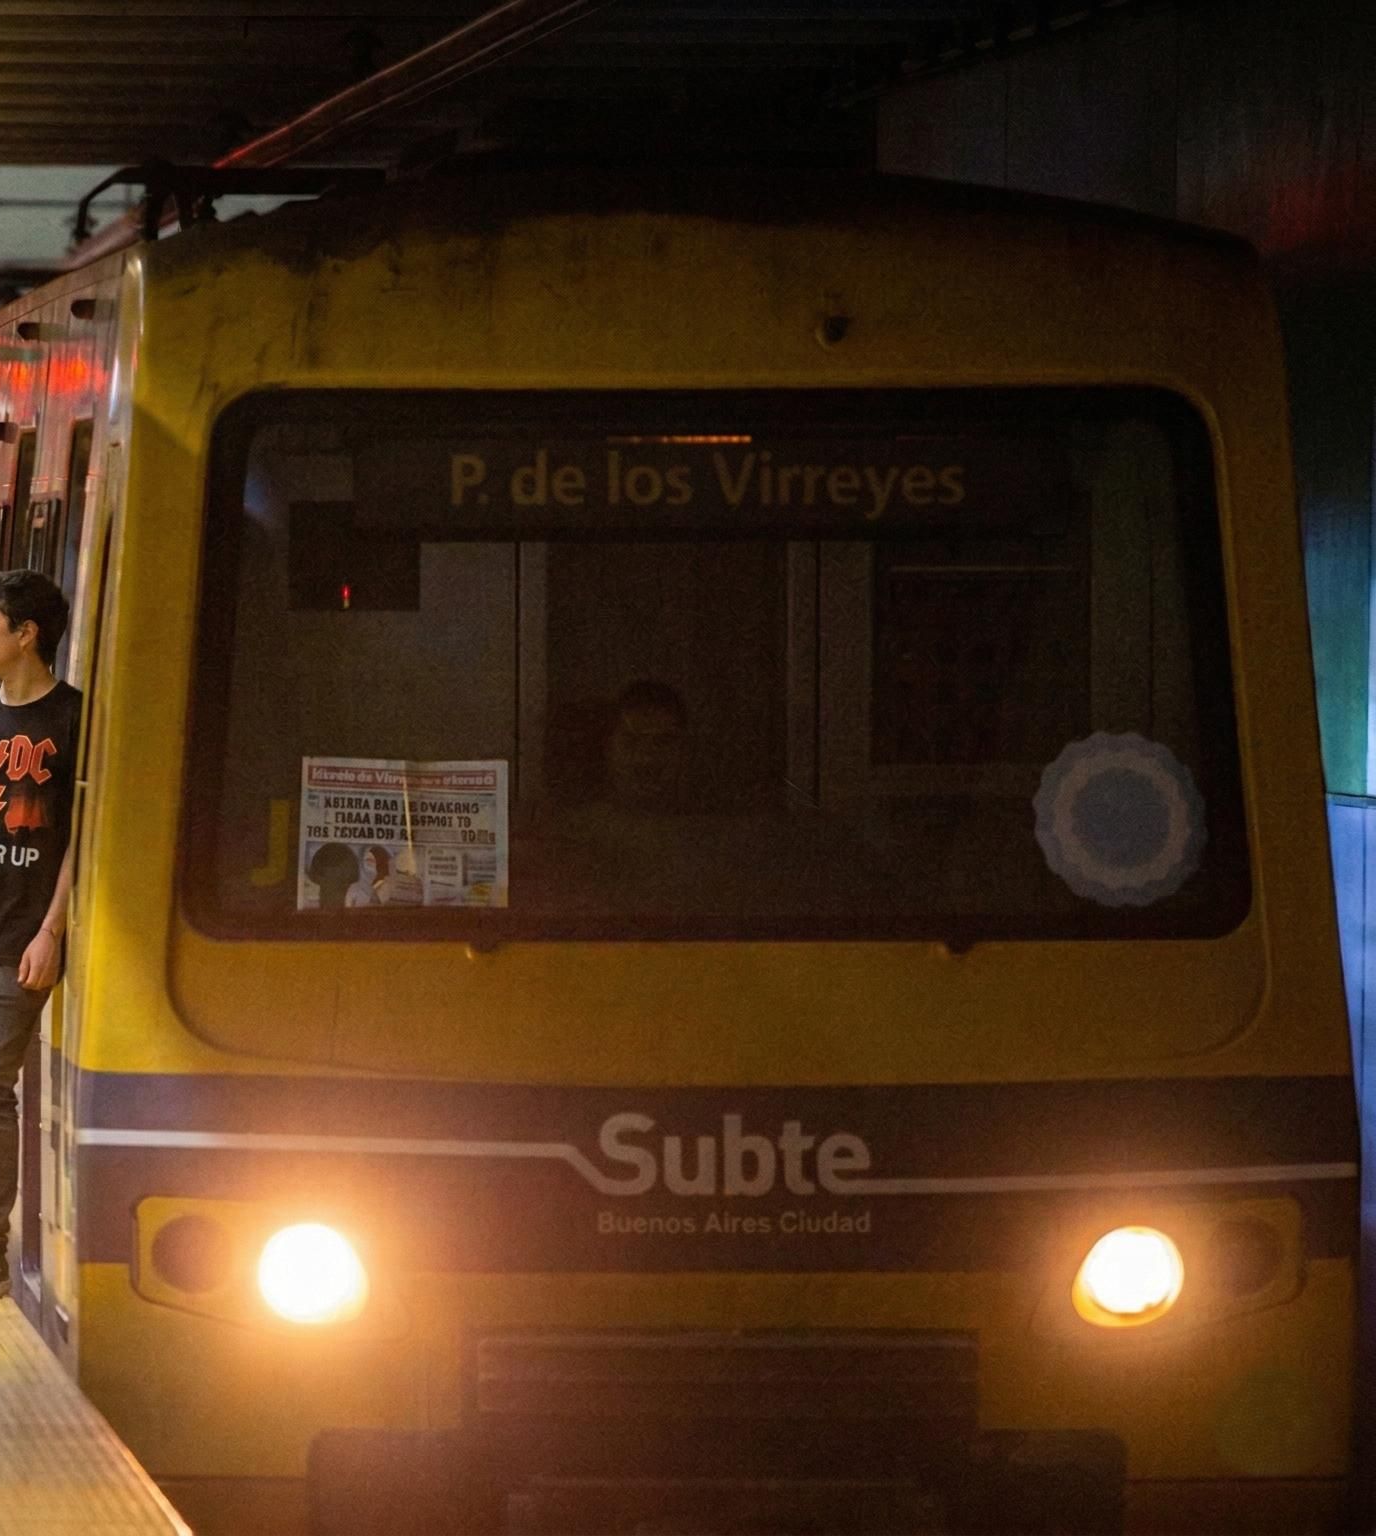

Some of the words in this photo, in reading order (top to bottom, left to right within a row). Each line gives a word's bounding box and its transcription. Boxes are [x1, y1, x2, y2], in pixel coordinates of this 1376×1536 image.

[448, 453, 490, 507] P.
[509, 448, 587, 507] de
[607, 449, 693, 507] los
[711, 450, 967, 521] Virreyes
[10, 845, 40, 868] UP
[599, 1112, 872, 1197] Subte
[597, 1211, 696, 1234] Buenos
[705, 1211, 772, 1234] Aires
[779, 1210, 872, 1234] Ciudad
